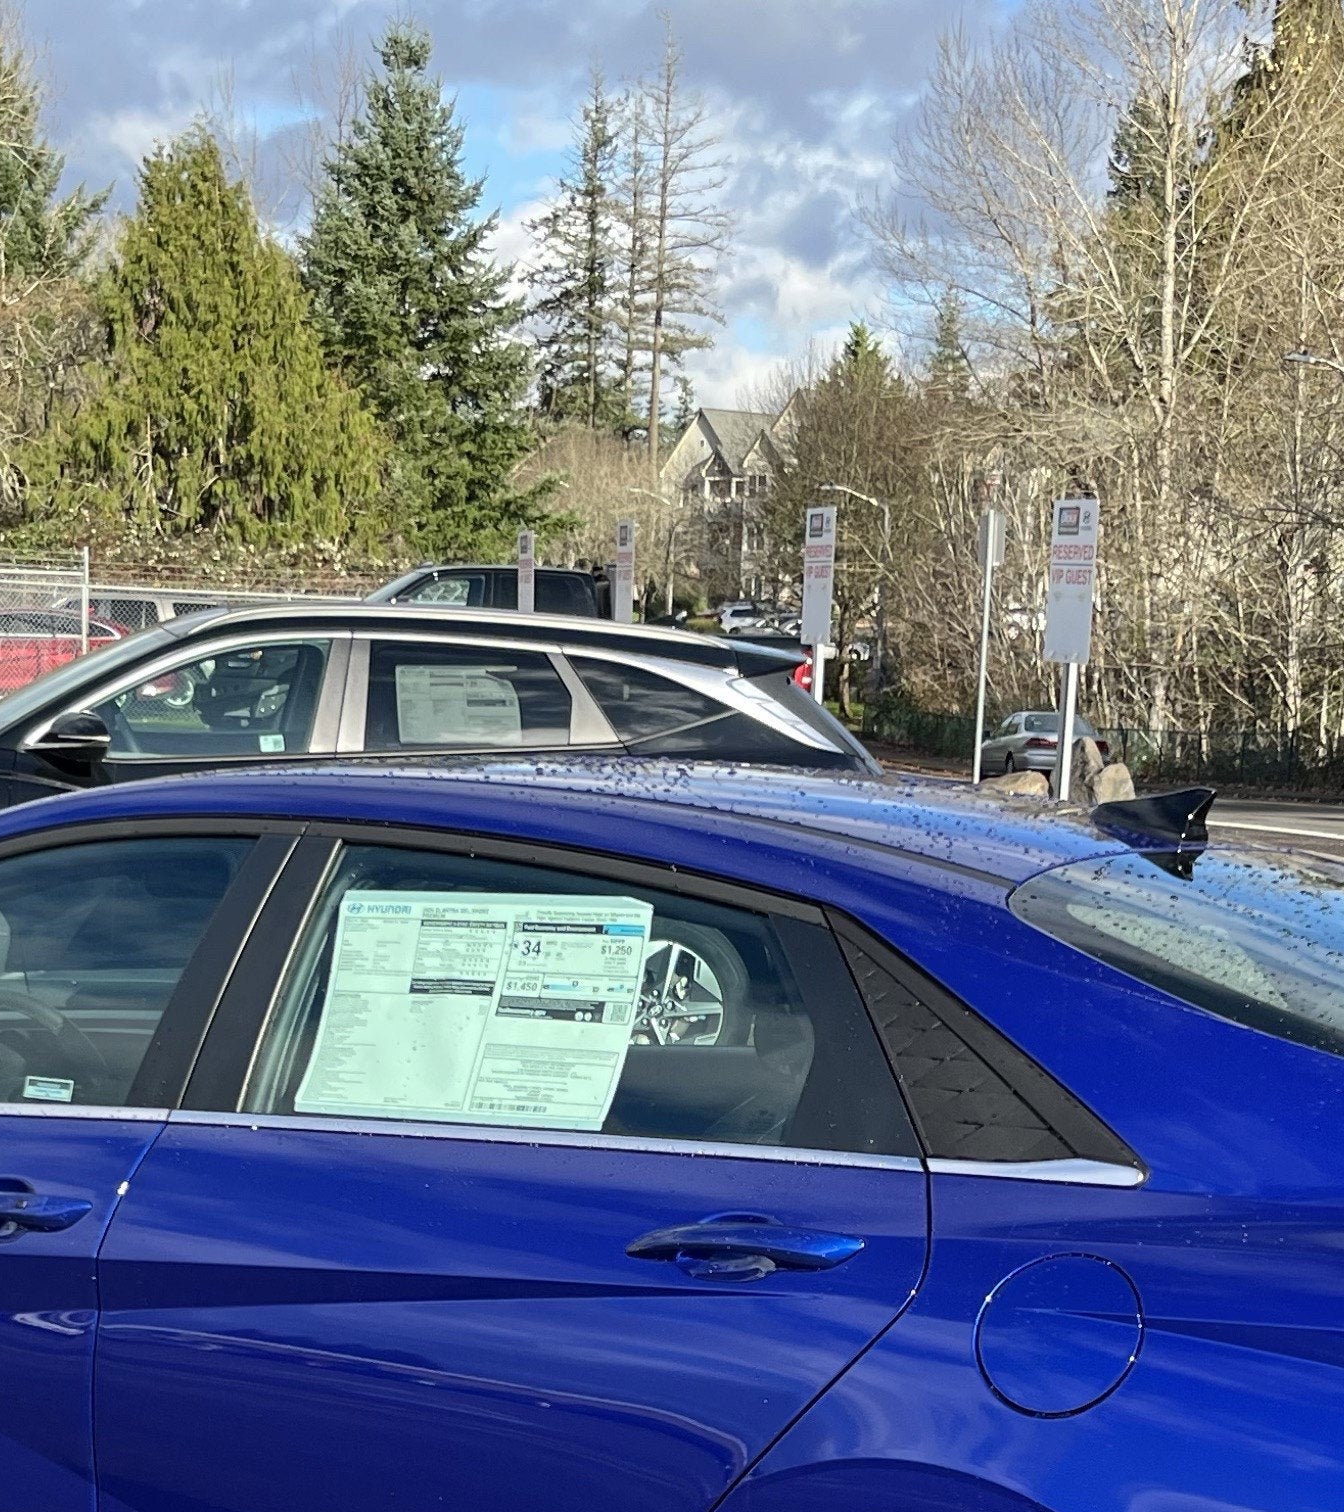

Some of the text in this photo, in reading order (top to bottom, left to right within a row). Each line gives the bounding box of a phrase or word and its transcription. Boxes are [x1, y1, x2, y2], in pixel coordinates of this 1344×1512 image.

[367, 904, 412, 914] HYUNDAI
[521, 940, 542, 956] 34
[601, 945, 632, 955] $1,250
[506, 981, 538, 991] $1,450
